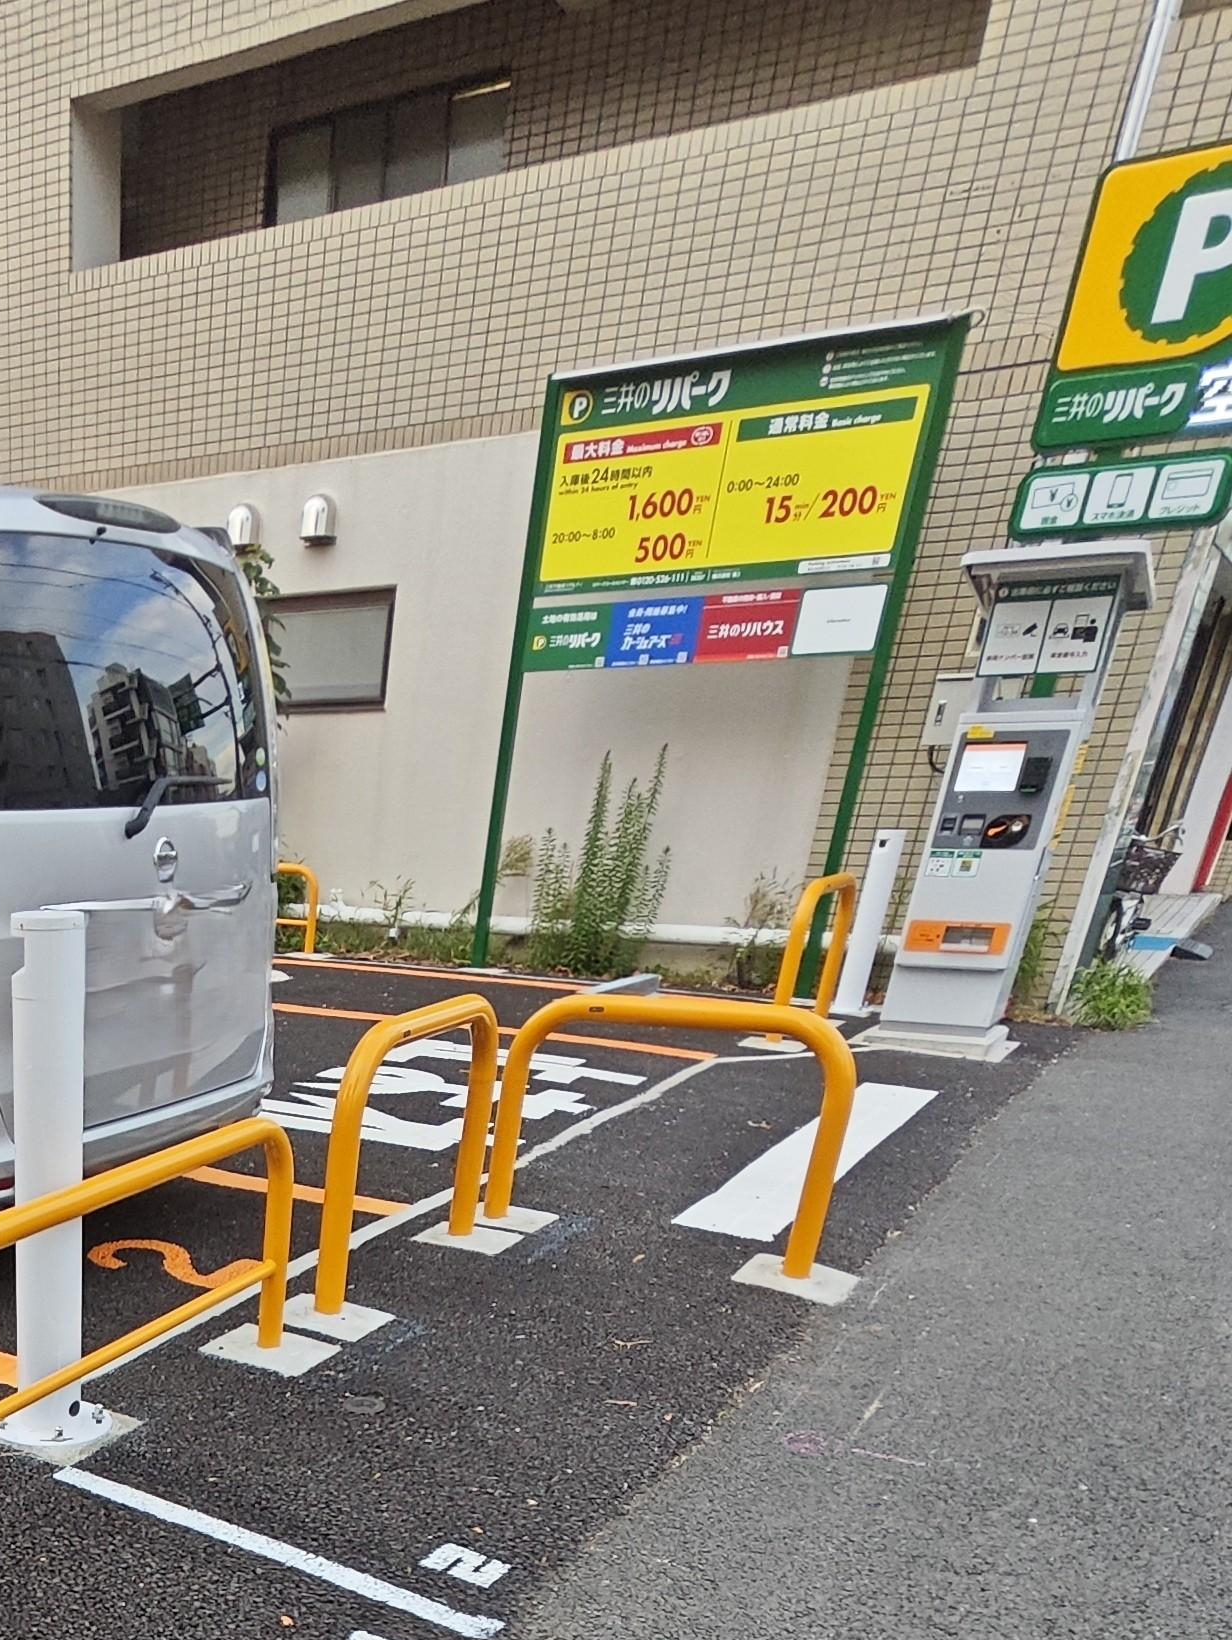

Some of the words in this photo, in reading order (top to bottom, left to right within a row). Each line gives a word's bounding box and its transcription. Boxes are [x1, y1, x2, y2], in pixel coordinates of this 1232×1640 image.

[1151, 186, 1232, 325] P
[601, 369, 733, 416] 三井のリパーク
[1052, 382, 1188, 424] 三井のリパーク
[768, 411, 830, 436] 通常料金
[570, 438, 625, 461] 最大料金
[559, 466, 653, 487] 入庫後24時間以内
[559, 487, 579, 495] within
[591, 484, 610, 492] hours
[619, 481, 639, 491] entry
[627, 488, 694, 522] 1,600
[695, 494, 711, 503] YEN
[692, 503, 702, 514] 円
[764, 495, 793, 524] 15
[818, 485, 878, 519] 200
[880, 492, 896, 501] YEN
[876, 502, 887, 513] 円
[1159, 503, 1200, 516] クレジット
[634, 532, 686, 563] 500
[688, 539, 702, 547] YEN
[684, 548, 695, 559] 円
[549, 632, 601, 649] 三井のリパーク
[623, 623, 651, 636] 三井の
[707, 620, 784, 640] 三井のリハウス
[87, 1238, 264, 1289] 2
[418, 1542, 512, 1589] 2
